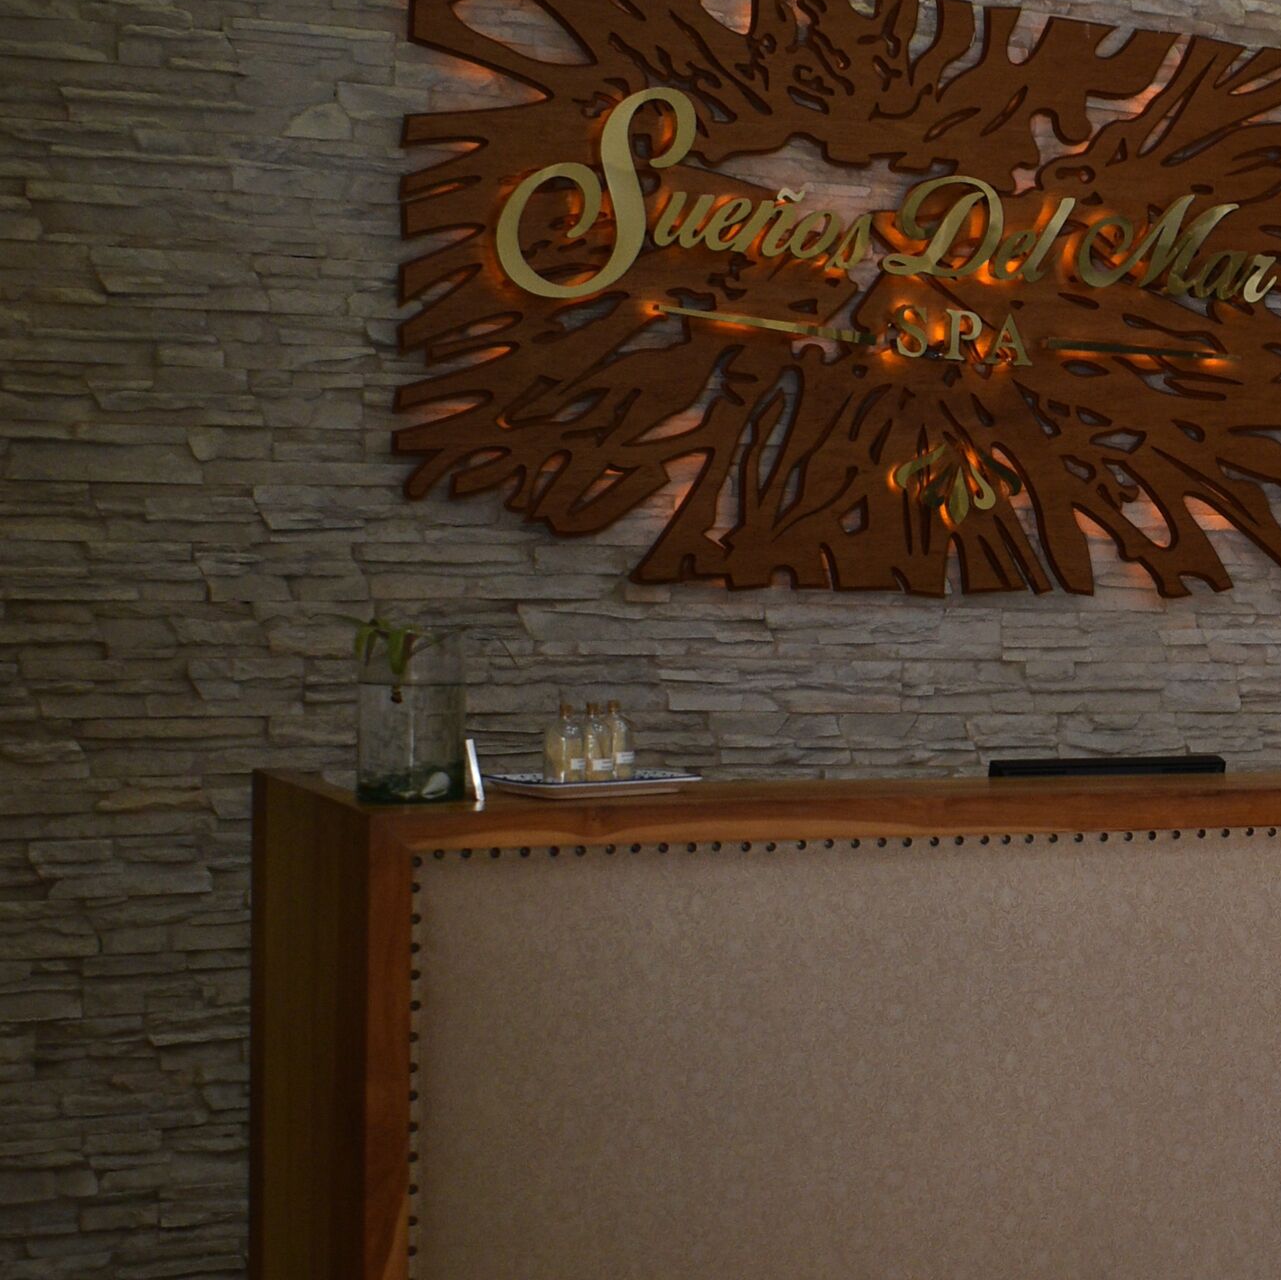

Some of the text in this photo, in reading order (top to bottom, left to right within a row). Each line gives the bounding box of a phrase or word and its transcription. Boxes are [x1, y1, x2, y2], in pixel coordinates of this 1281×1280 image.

[495, 87, 1277, 304] Sueños Del Mar
[894, 305, 1031, 367] SPA
